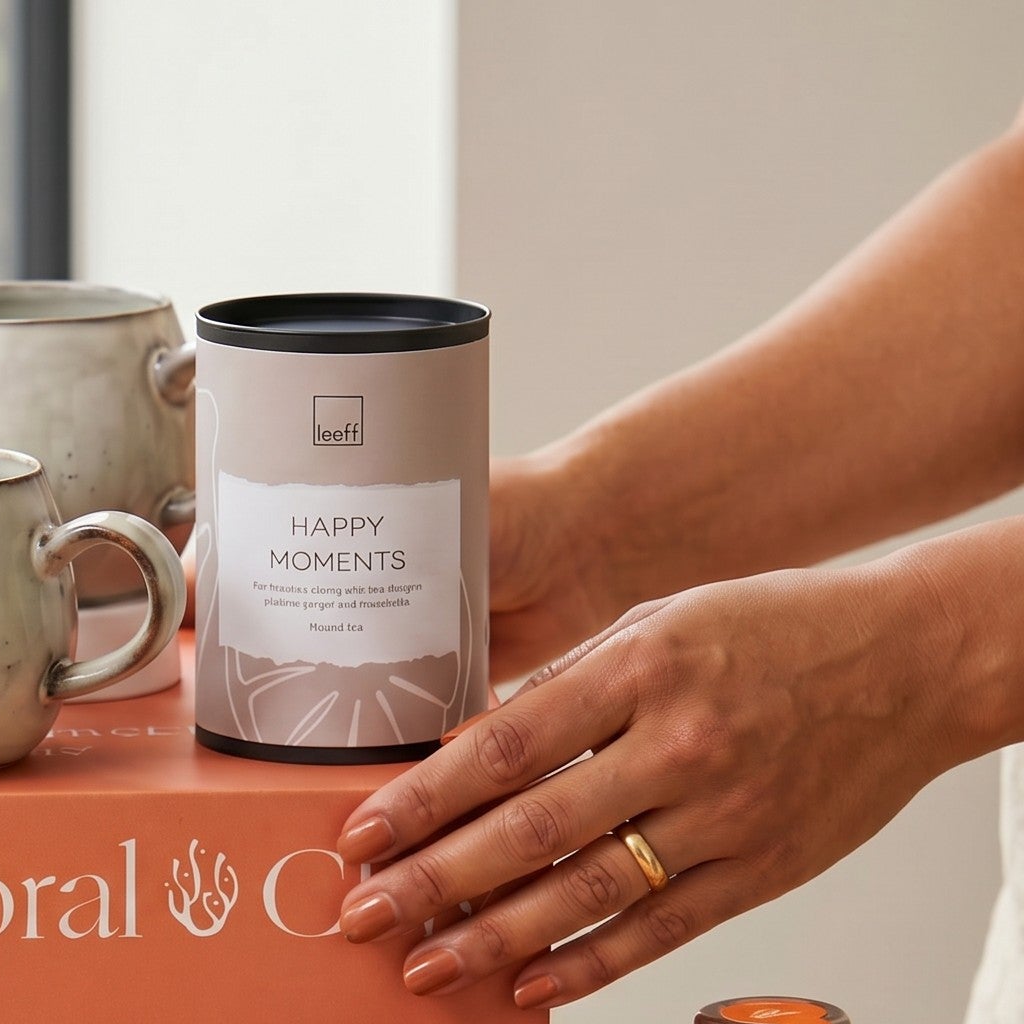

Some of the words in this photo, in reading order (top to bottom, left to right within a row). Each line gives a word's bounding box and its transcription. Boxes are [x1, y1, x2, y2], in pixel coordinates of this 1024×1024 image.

[317, 423, 360, 442] leeff
[291, 516, 384, 537] HAPPY
[270, 549, 406, 572] MOMENTS
[347, 623, 364, 632] tea
